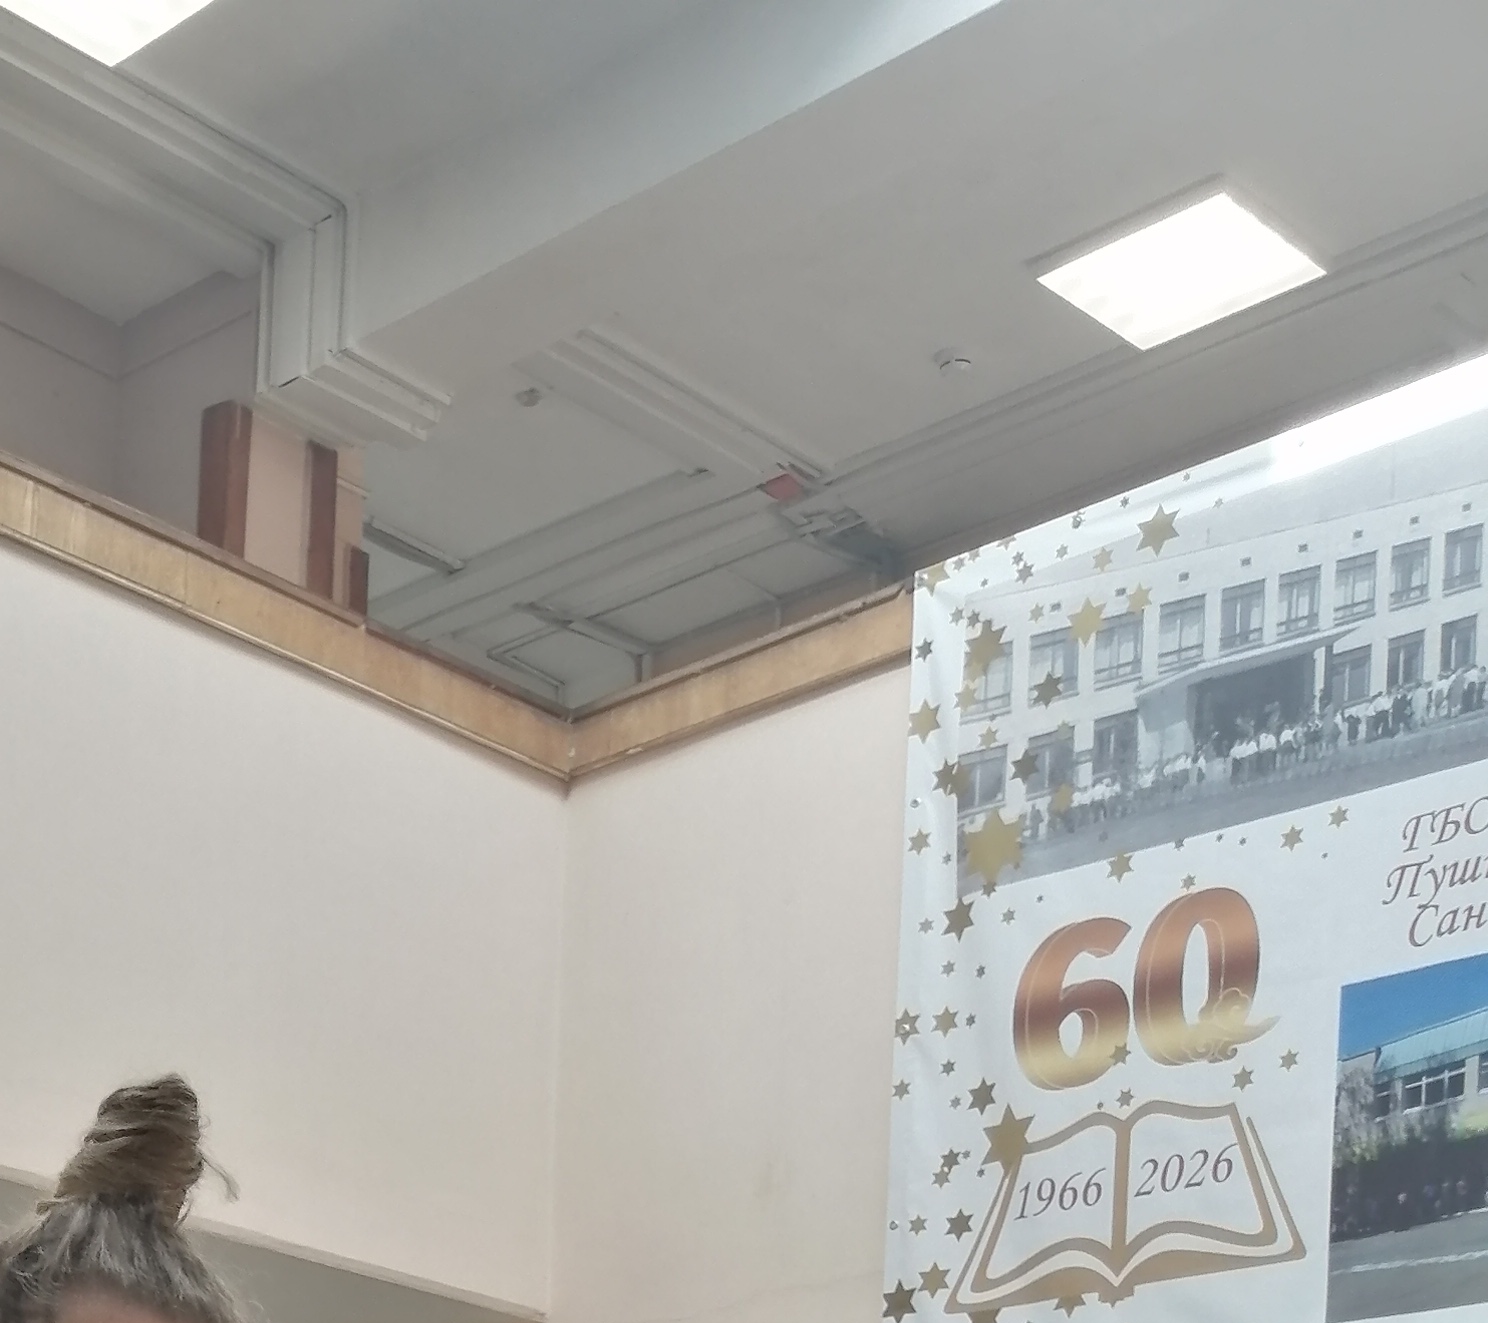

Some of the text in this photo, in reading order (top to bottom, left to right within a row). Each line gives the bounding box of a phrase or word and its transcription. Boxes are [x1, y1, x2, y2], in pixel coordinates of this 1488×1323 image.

[1382, 854, 1488, 909] Пуш
[1013, 887, 1280, 1090] 60
[1015, 1167, 1107, 1220] 1966
[1134, 1143, 1239, 1198] 2026
